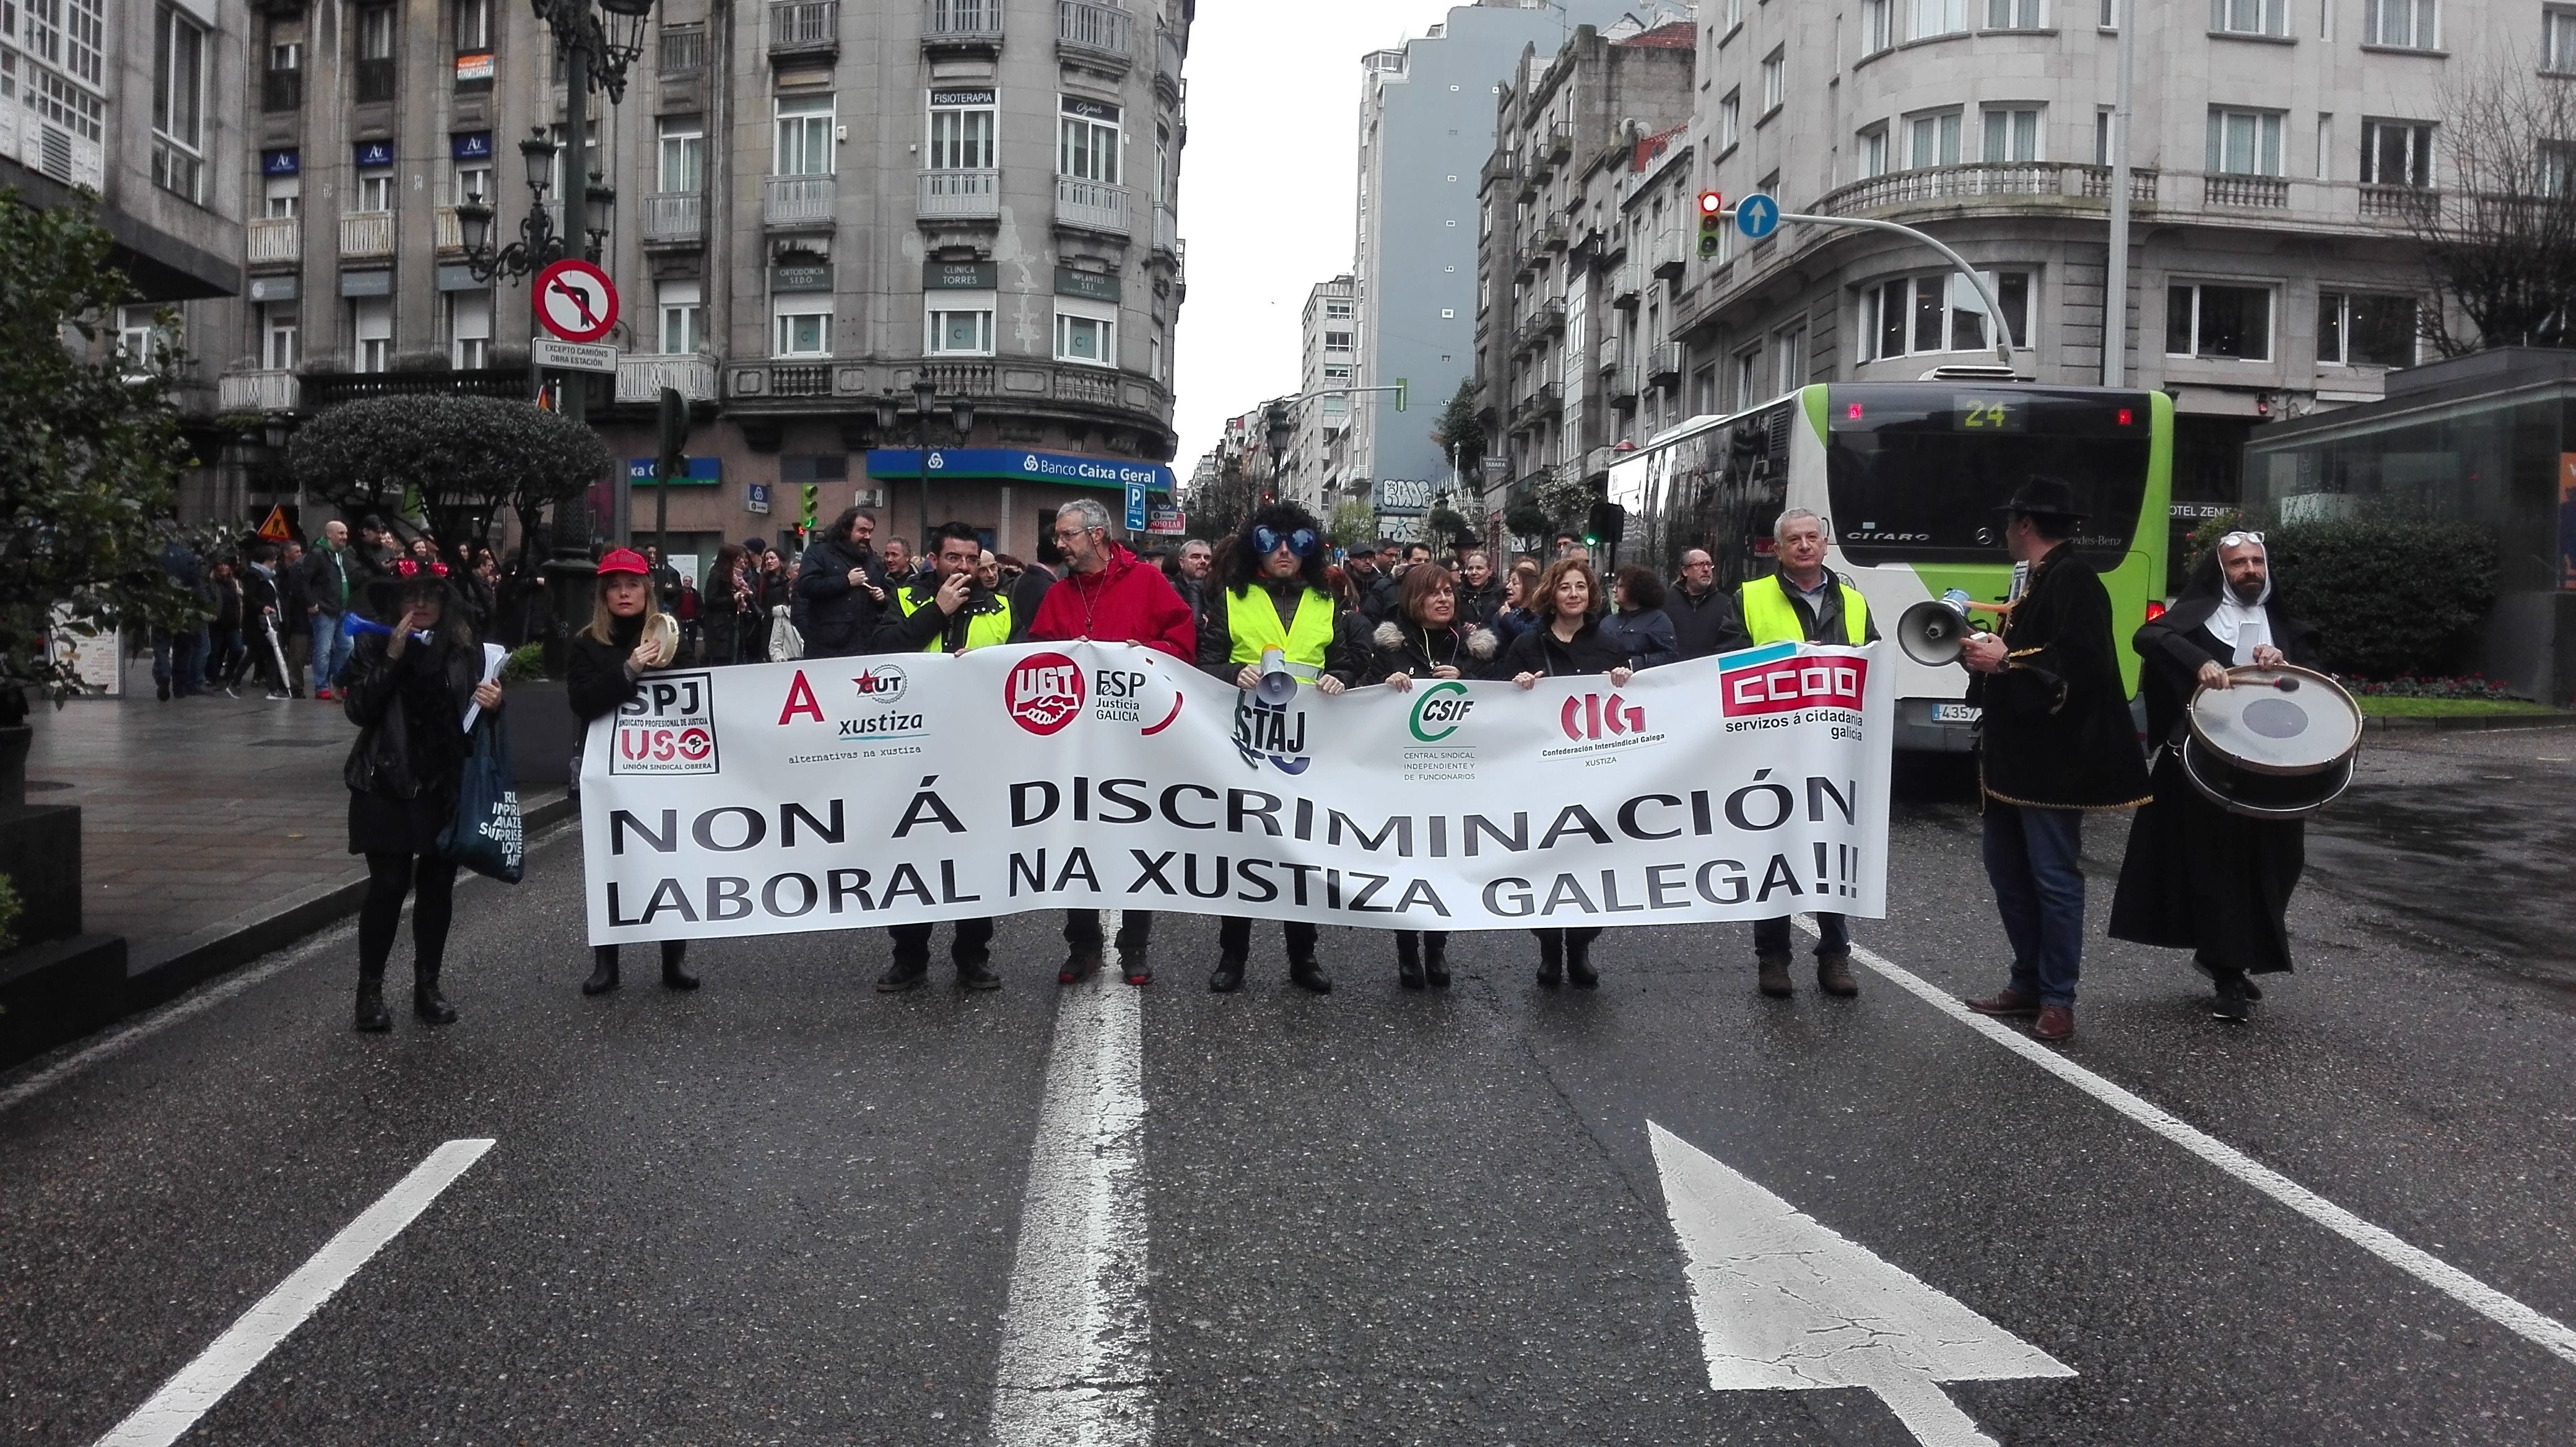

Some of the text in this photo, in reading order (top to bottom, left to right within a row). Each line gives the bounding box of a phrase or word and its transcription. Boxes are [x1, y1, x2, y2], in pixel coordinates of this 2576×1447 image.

[934, 93, 992, 103] FISIOTERAPIA
[780, 268, 824, 276] ORTODONCIA
[942, 276, 977, 284] TORRES
[1071, 273, 1105, 284] IMPLANTES
[545, 344, 608, 357] EXCEPTO CAMIÓNS
[550, 354, 603, 367] OBRA ESTACIÓN
[1965, 400, 2006, 427] 24
[1041, 460, 1155, 483] Banco Caixa Geral
[1131, 488, 1141, 506] P
[2169, 505, 2232, 517] OTEL ZENI
[2068, 535, 2121, 545] cedes-Benz
[861, 676, 901, 694] CUT
[1016, 665, 1075, 699] UGT
[1733, 667, 1857, 705] CCOO
[621, 681, 700, 717] SPJ
[777, 669, 825, 725] A
[1095, 697, 1140, 710] Justicia
[1096, 710, 1139, 722] GALICIA
[1423, 699, 1474, 722] CSIF
[1560, 693, 1646, 743] CIG
[1942, 706, 1978, 719] 4357
[619, 719, 644, 727] SINDICATO
[645, 719, 679, 727] PROFESIONAL
[688, 717, 708, 725] JUSTICIA
[838, 710, 923, 735] xustiza
[1236, 704, 1305, 753] STAJ
[1725, 710, 1863, 732] servizos á cidadanía
[1831, 726, 1863, 741] galicia
[621, 728, 711, 761] USO
[1542, 733, 1665, 756] Confederación Intersindical Galega
[788, 751, 858, 764] alternativas
[881, 745, 921, 756] xustiza
[1585, 756, 1617, 767] XUSTIZA
[610, 768, 1856, 857] NON Á DISCRIMINACIÓN
[502, 841, 523, 854] LOVE
[506, 854, 521, 867] ART
[606, 842, 1858, 927] LABORAL NA XUSTIZA GALEGA!!!
